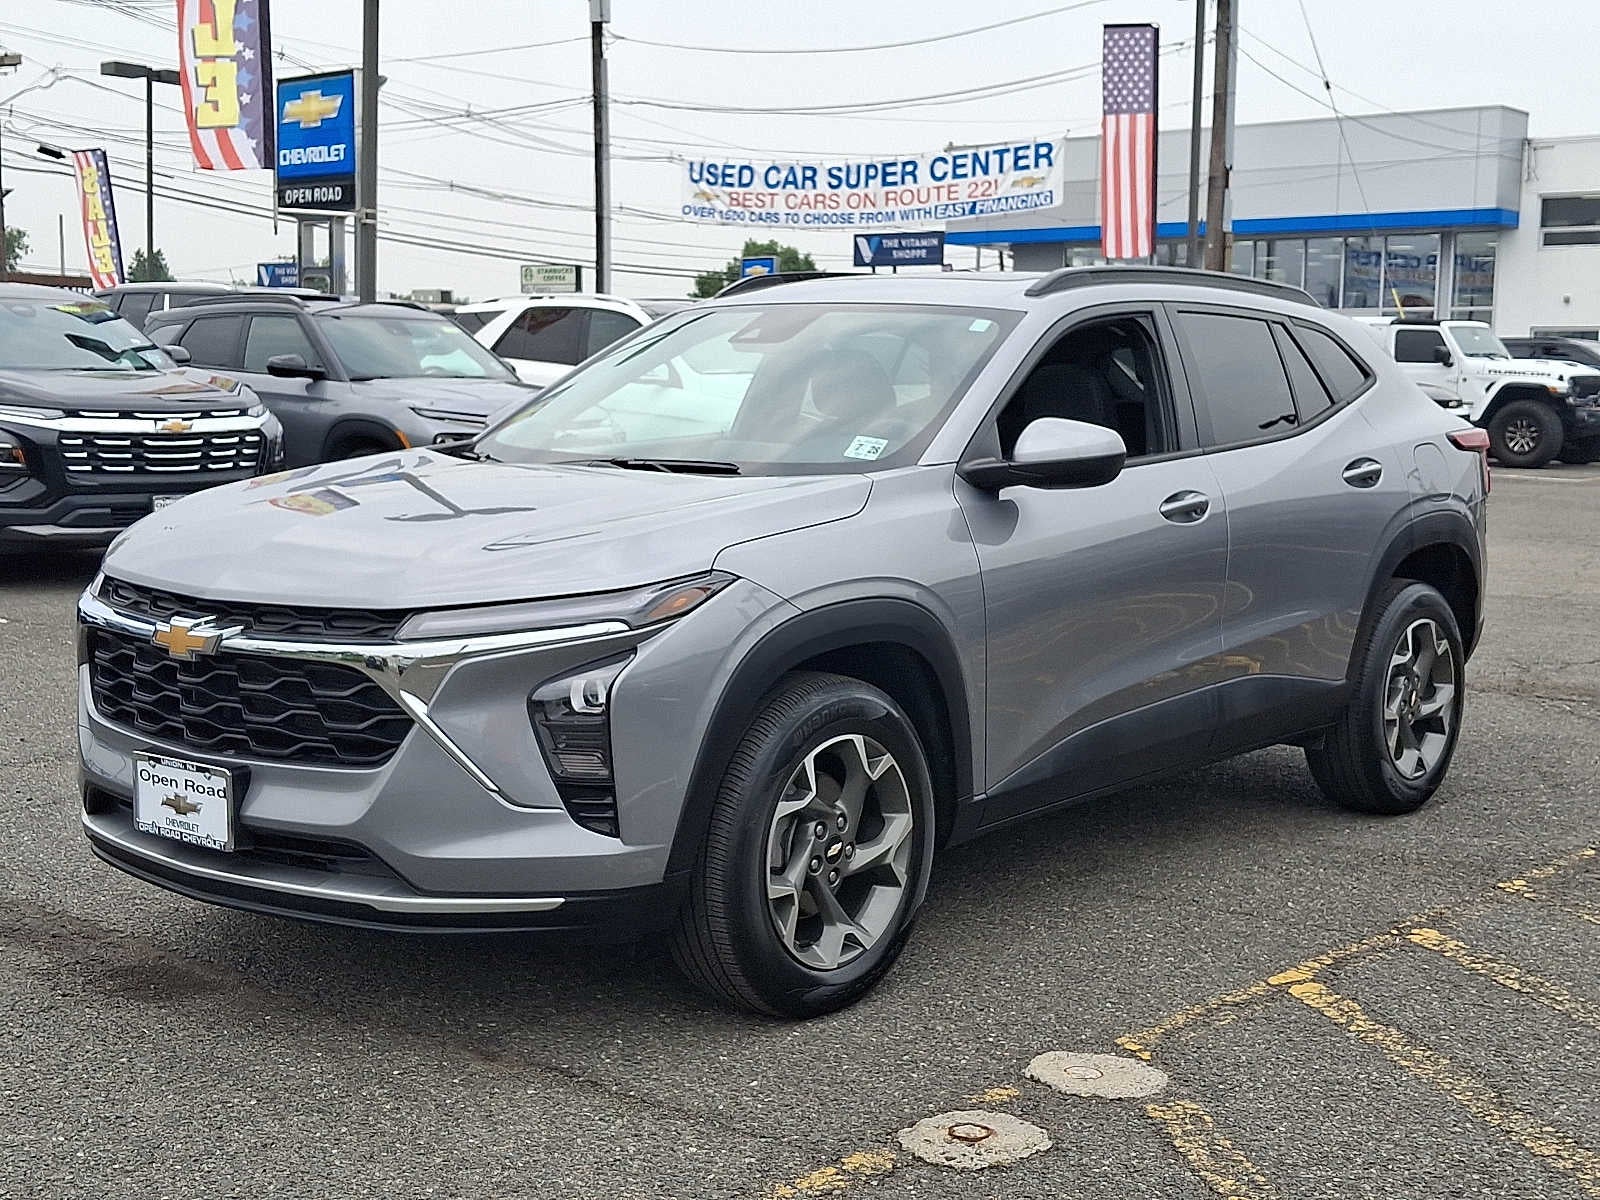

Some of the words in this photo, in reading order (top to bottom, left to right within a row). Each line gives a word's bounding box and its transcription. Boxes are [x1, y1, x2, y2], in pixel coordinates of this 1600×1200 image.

[279, 143, 346, 166] CHEVROLET
[688, 162, 755, 188] USED
[764, 165, 818, 190] CAR
[827, 159, 918, 190] SUPER
[929, 142, 1054, 182] CENTER
[285, 187, 313, 205] OPEN
[313, 186, 342, 203] ROAD
[682, 204, 715, 219] OVER
[749, 212, 780, 224] CARS
[785, 212, 801, 225] TO
[803, 212, 856, 225] CHOOSE
[859, 210, 896, 225] FROM
[900, 207, 932, 222] WITH
[936, 203, 973, 218] EASY
[975, 192, 1052, 214] FINANCING
[728, 191, 779, 208] BEST
[785, 193, 840, 210] CARS
[846, 192, 877, 209] ON
[885, 184, 960, 207] ROUTE
[967, 179, 999, 199] 22!
[882, 239, 900, 249] THE
[901, 237, 939, 247] VITAMIN
[139, 768, 179, 789] Open
[184, 778, 227, 799] Road
[138, 822, 159, 835] OPEN
[160, 827, 181, 840] ROAD
[182, 833, 225, 851] CHEVROLET
[165, 816, 200, 832] CHEVROLET
